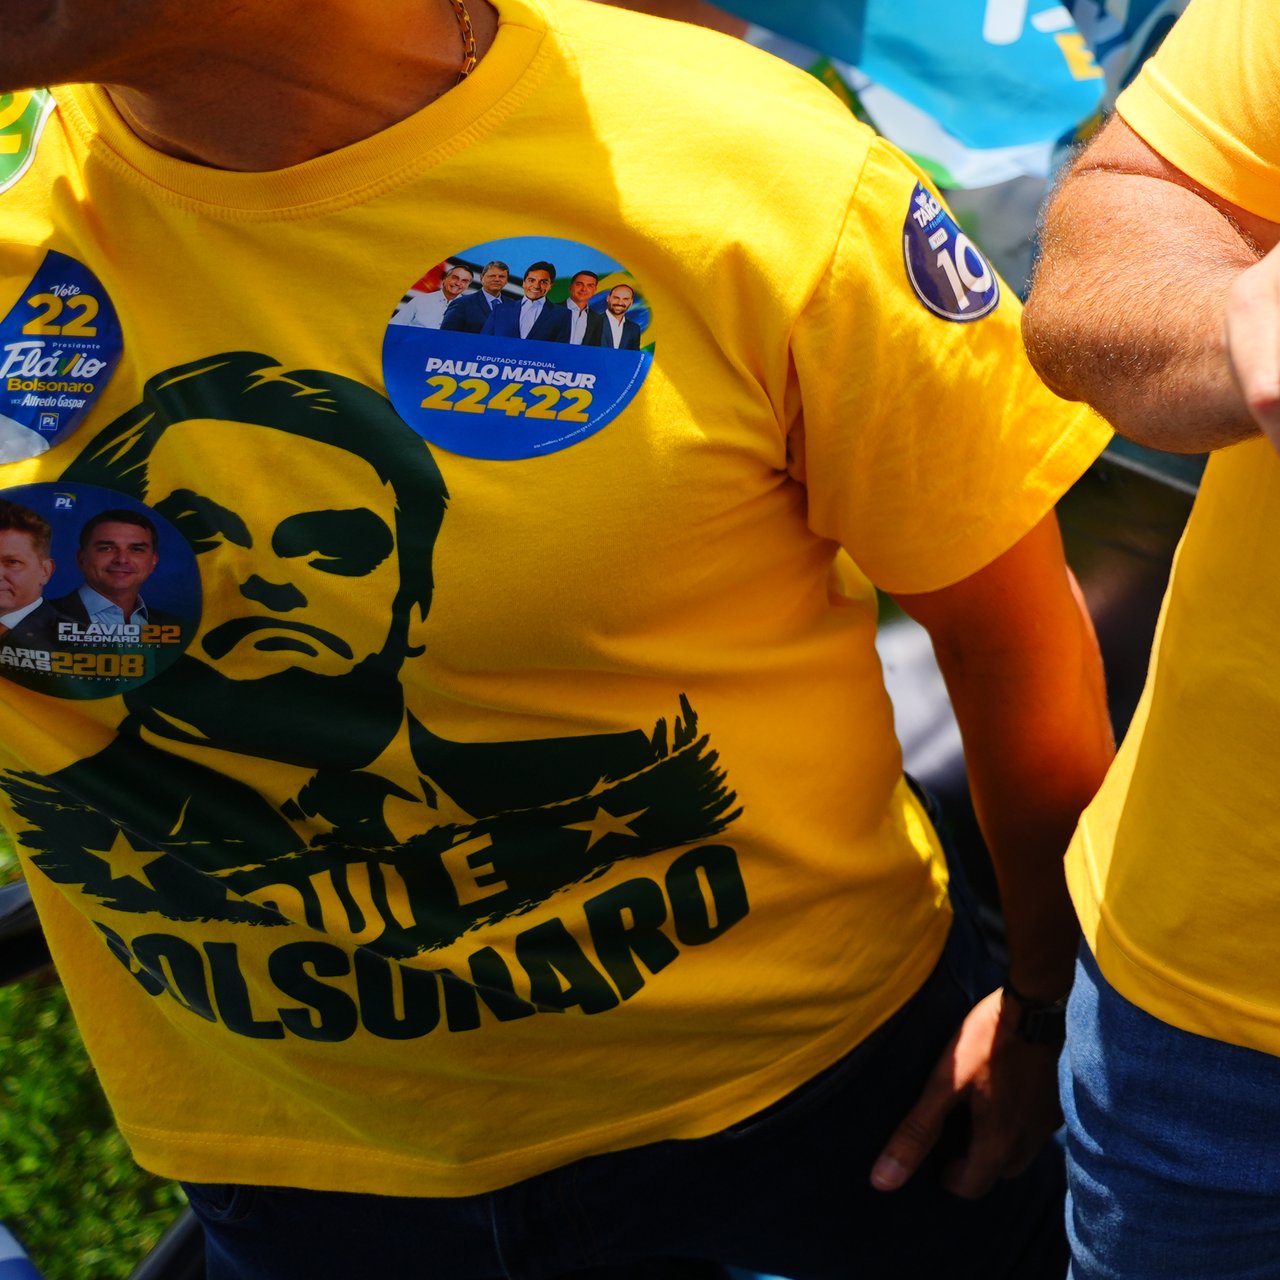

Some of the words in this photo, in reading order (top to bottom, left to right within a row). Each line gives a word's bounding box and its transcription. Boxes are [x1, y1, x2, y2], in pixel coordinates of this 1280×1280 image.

[937, 232, 993, 310] 10
[50, 282, 81, 298] Vote
[22, 293, 99, 337] 22
[52, 341, 101, 350] Presidente
[0, 341, 107, 379] Flávio
[476, 355, 517, 365] DEPUTADO
[518, 359, 556, 369] ESTADUAL
[425, 357, 500, 379] PAULO
[501, 366, 596, 389] MANSUR
[7, 378, 95, 393] Bolsonaro
[22, 393, 57, 408] Alfredo
[57, 394, 86, 410] Gaspar
[420, 375, 593, 423] 22422
[43, 417, 55, 426] PL
[56, 497, 72, 508] PL
[58, 620, 140, 635] FLÁVIO
[141, 624, 181, 644] 22
[58, 634, 140, 643] BOLSONARO
[0, 646, 50, 661] ARIO
[0, 655, 52, 671] RIAS
[51, 651, 145, 677] 2208
